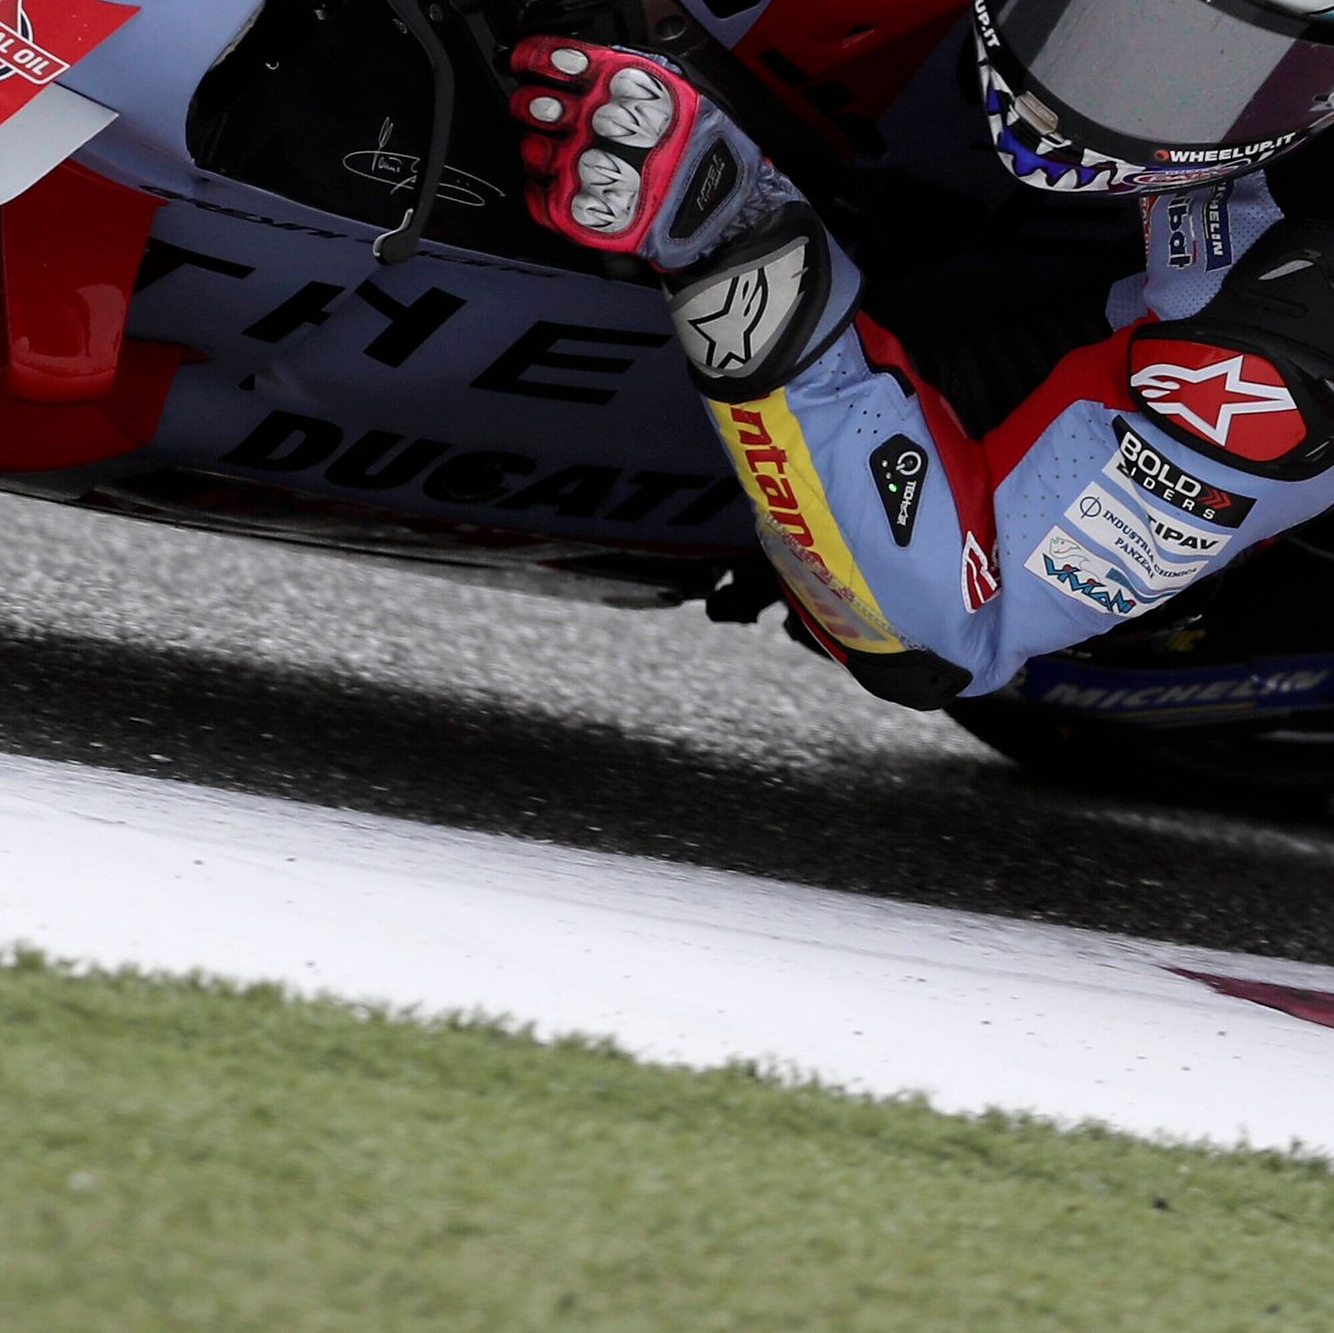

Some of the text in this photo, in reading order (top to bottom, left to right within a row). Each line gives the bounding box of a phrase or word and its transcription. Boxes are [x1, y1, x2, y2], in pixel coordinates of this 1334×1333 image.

[12, 43, 53, 77] OIL
[1170, 132, 1296, 163] WHEELUP.IT
[220, 409, 749, 526] DUCATI
[1120, 431, 1201, 497] BOLD
